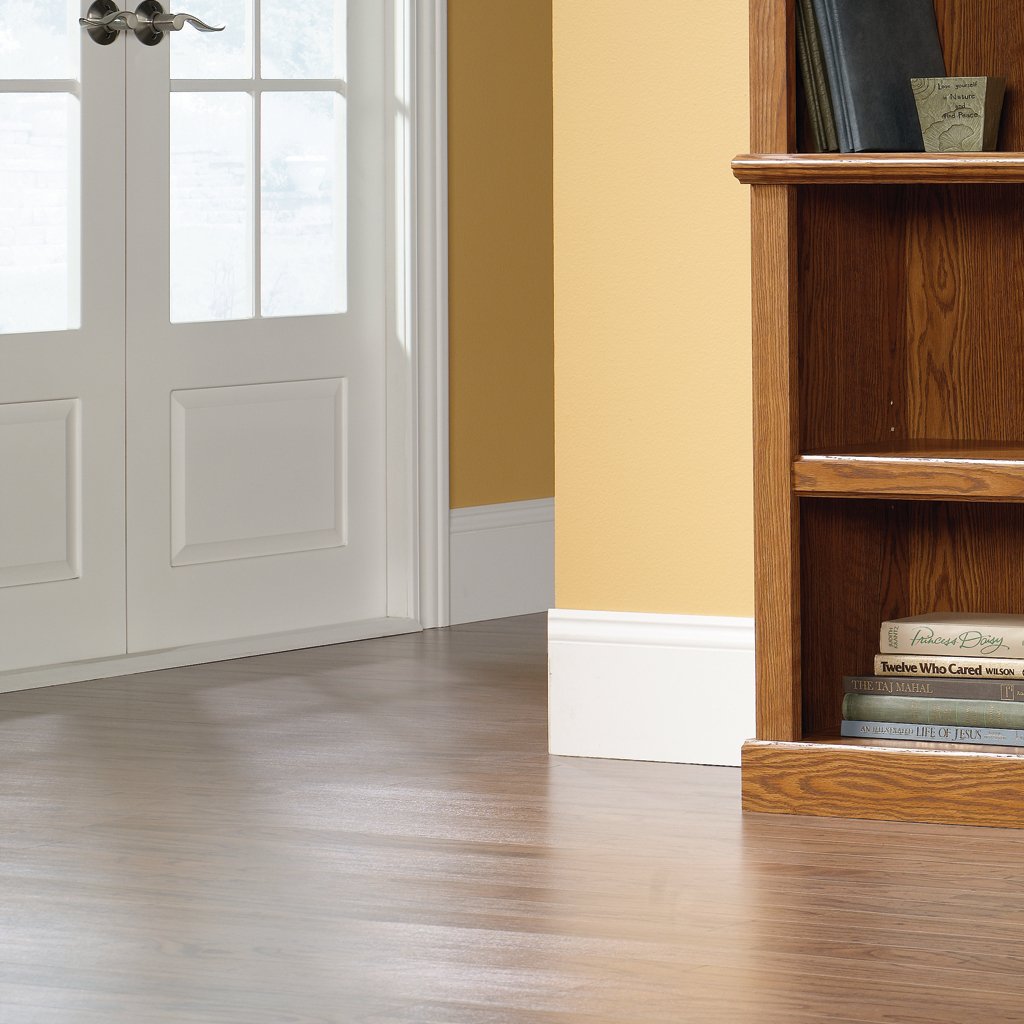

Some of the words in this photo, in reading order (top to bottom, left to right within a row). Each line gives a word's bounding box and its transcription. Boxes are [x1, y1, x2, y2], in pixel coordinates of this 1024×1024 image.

[955, 81, 978, 90] yourself
[892, 625, 900, 649] KRANTZ
[910, 626, 958, 647] Princess
[958, 630, 1010, 655] Daisy
[880, 661, 918, 673] Twelve
[919, 662, 948, 674] Who
[948, 663, 982, 676] Cared
[985, 667, 1015, 676] WILSON
[851, 680, 874, 690] THE
[875, 681, 893, 693] TAJ
[896, 682, 933, 694] MAHAL
[860, 725, 871, 733] AN
[916, 726, 936, 738] LIFE
[938, 728, 951, 738] OF
[952, 728, 982, 740] JESUS
